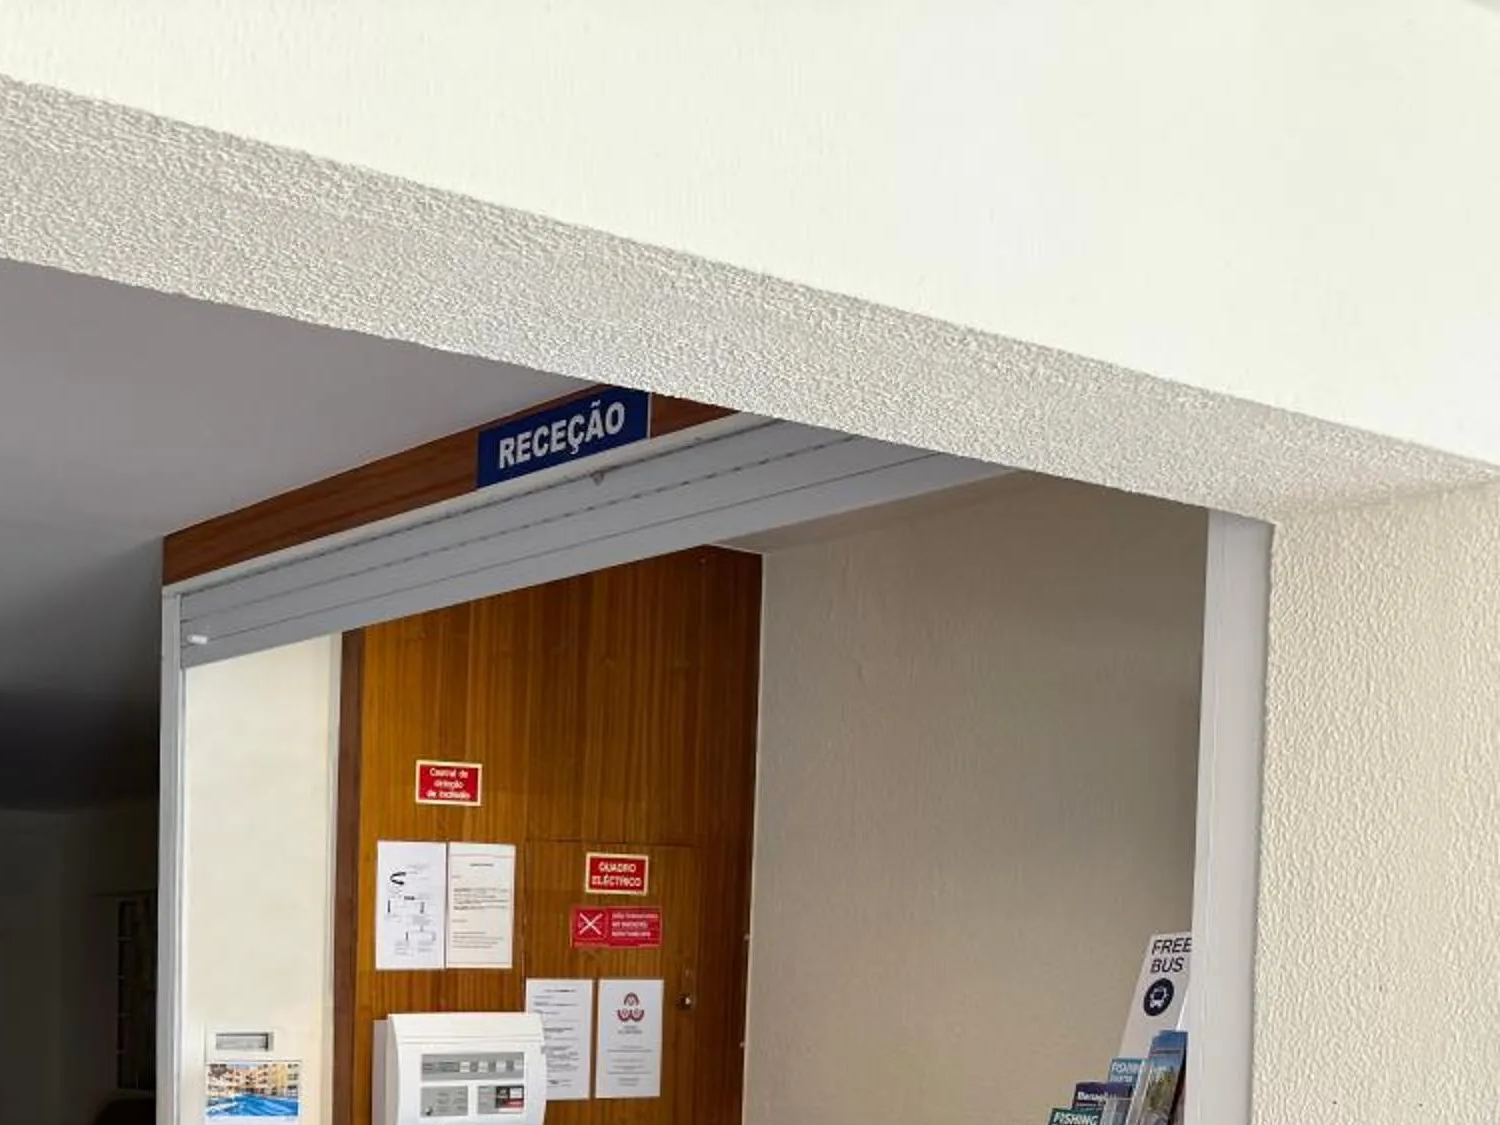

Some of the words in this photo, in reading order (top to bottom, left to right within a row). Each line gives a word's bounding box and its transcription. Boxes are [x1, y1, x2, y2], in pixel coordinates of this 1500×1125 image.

[499, 400, 626, 470] RECEÇÃO
[598, 861, 637, 873] QUADRO
[1151, 937, 1192, 955] FREE
[1150, 956, 1185, 973] BUS
